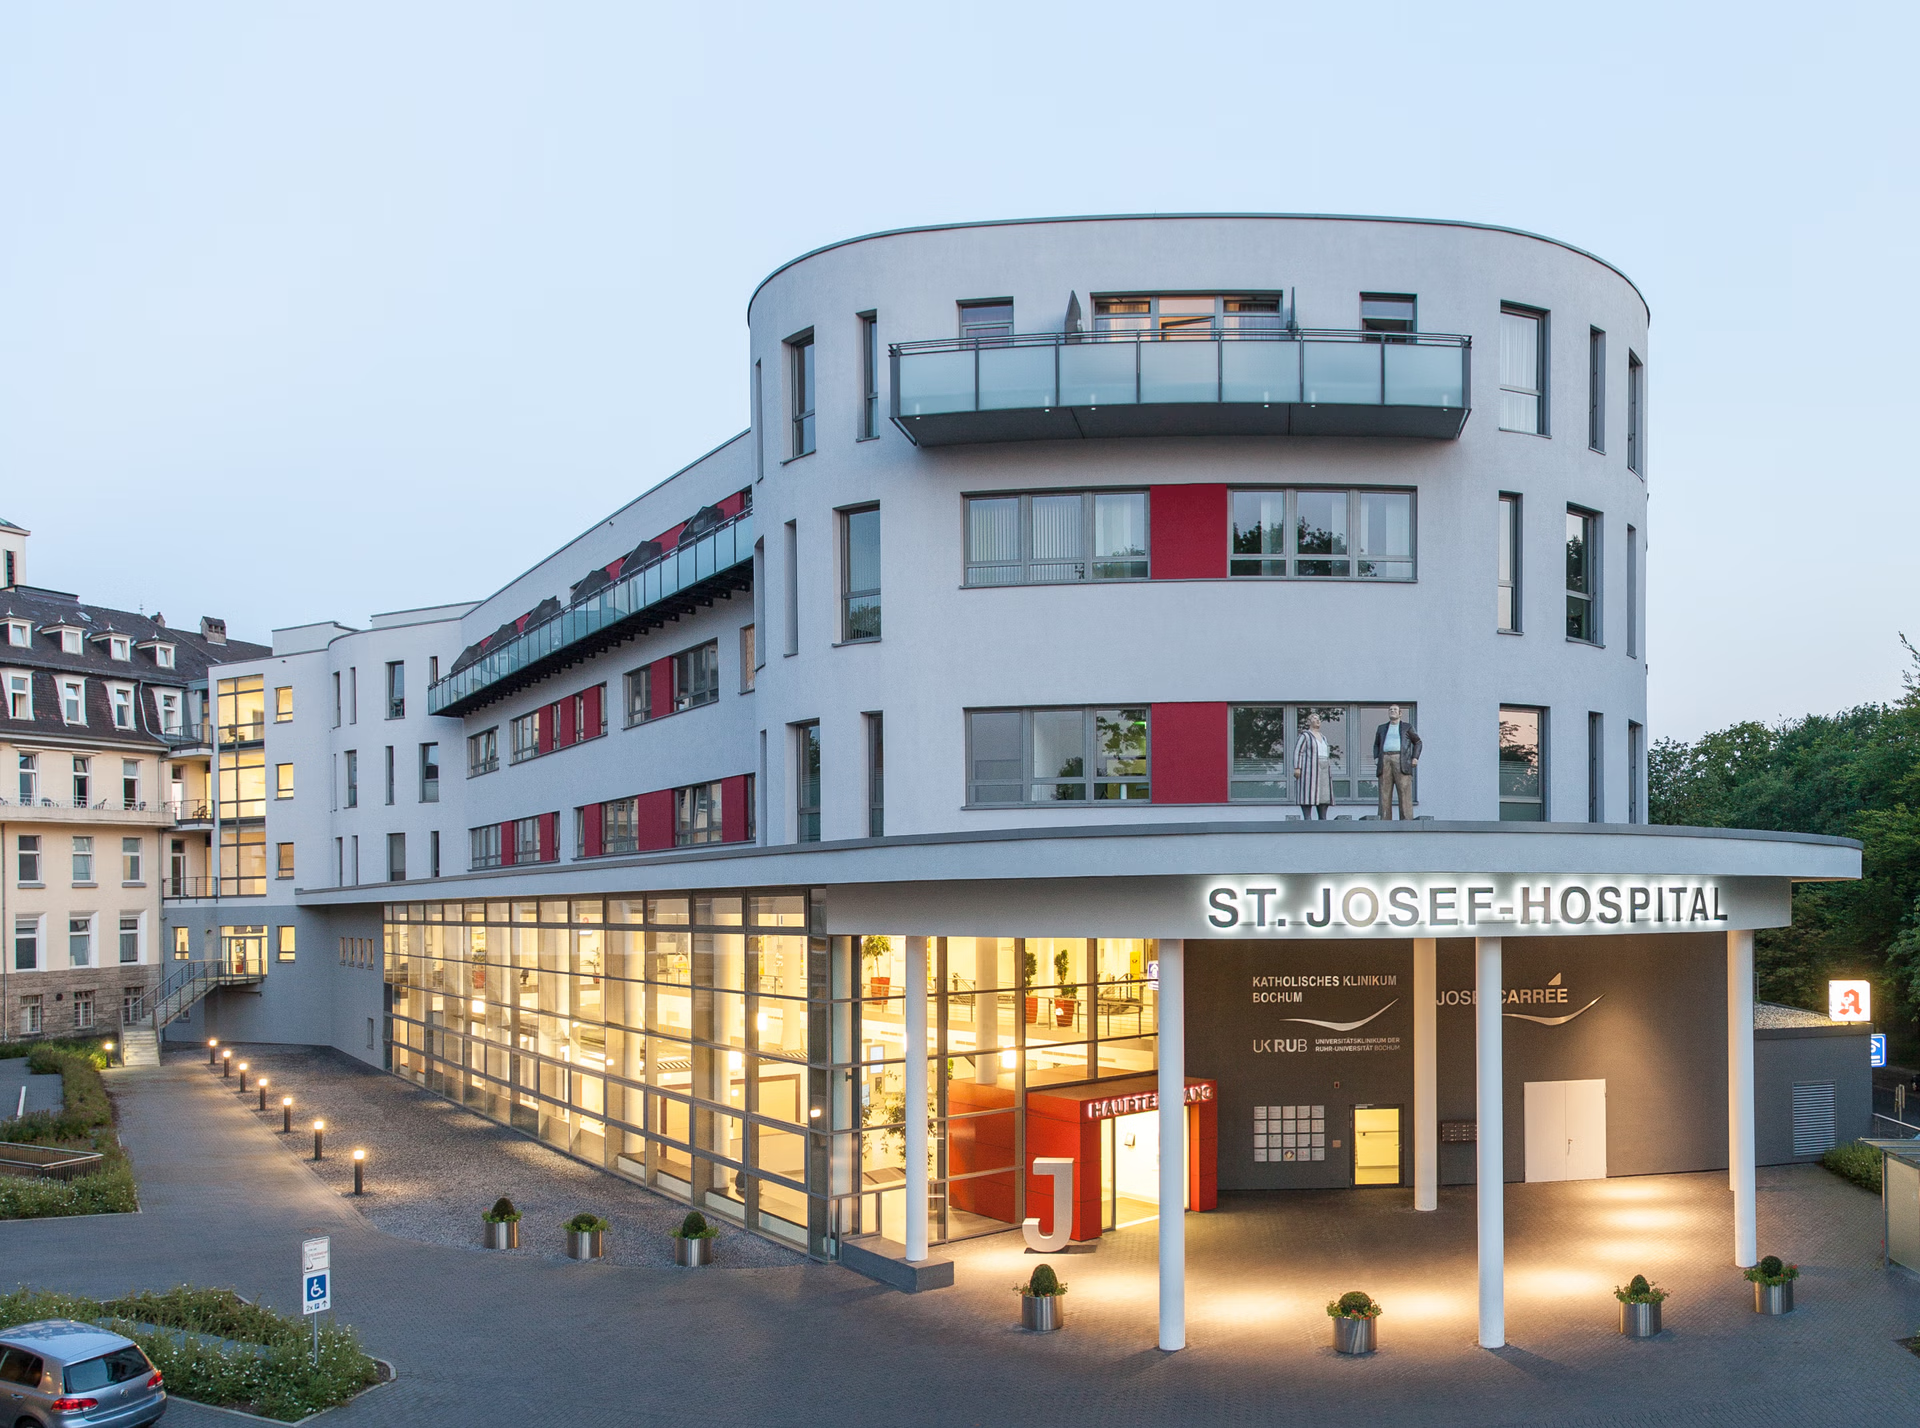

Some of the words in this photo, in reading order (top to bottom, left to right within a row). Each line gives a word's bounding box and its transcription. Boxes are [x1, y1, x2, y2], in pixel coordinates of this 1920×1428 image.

[1208, 887, 1287, 928] ST.
[1306, 886, 1729, 928] JOSEF-HOSPITAL
[1252, 976, 1340, 988] KATHOLISCHES
[1342, 975, 1397, 987] KLINIKUM
[1252, 992, 1303, 1003] BOCHUM
[1436, 990, 1477, 1006] JOS
[1022, 1157, 1074, 1252] J
